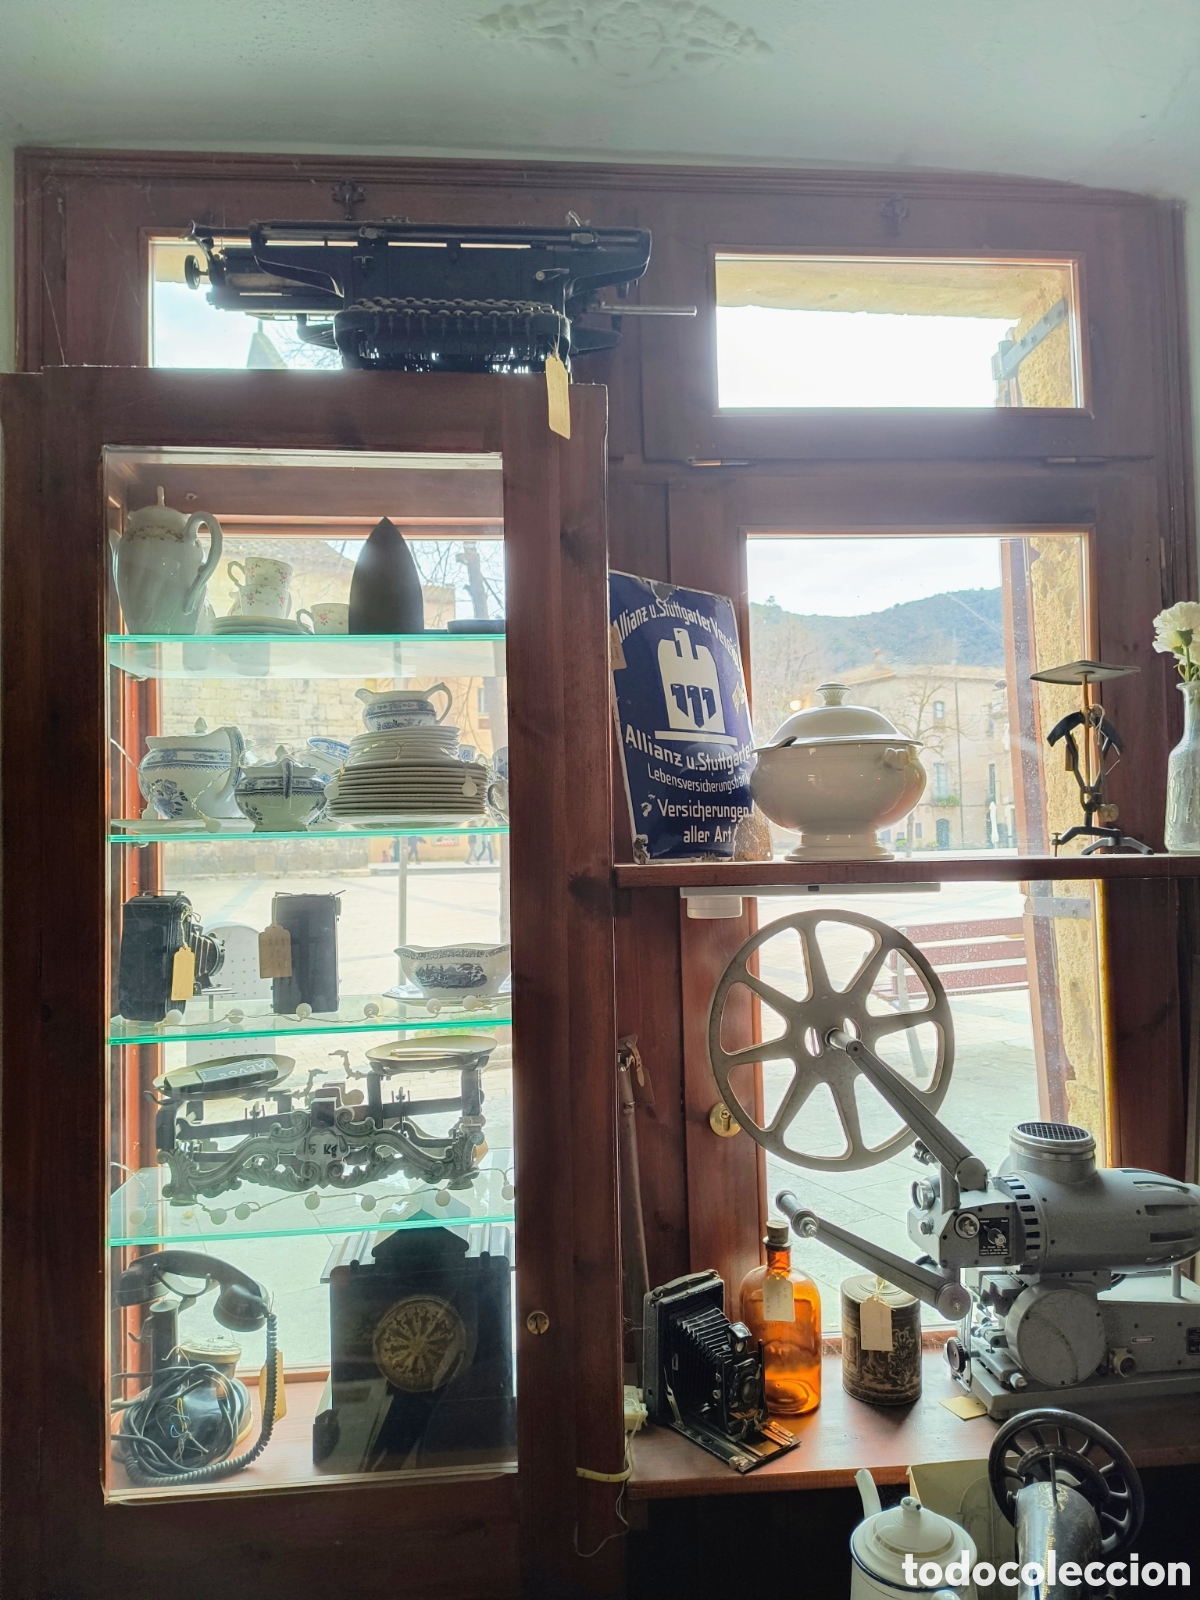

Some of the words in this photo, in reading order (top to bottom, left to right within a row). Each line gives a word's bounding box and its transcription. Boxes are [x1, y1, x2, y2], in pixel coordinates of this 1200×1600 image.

[625, 723, 684, 768] Allianz
[657, 799, 749, 823] Versicherungen
[683, 825, 710, 843] aller
[714, 826, 732, 843] Art
